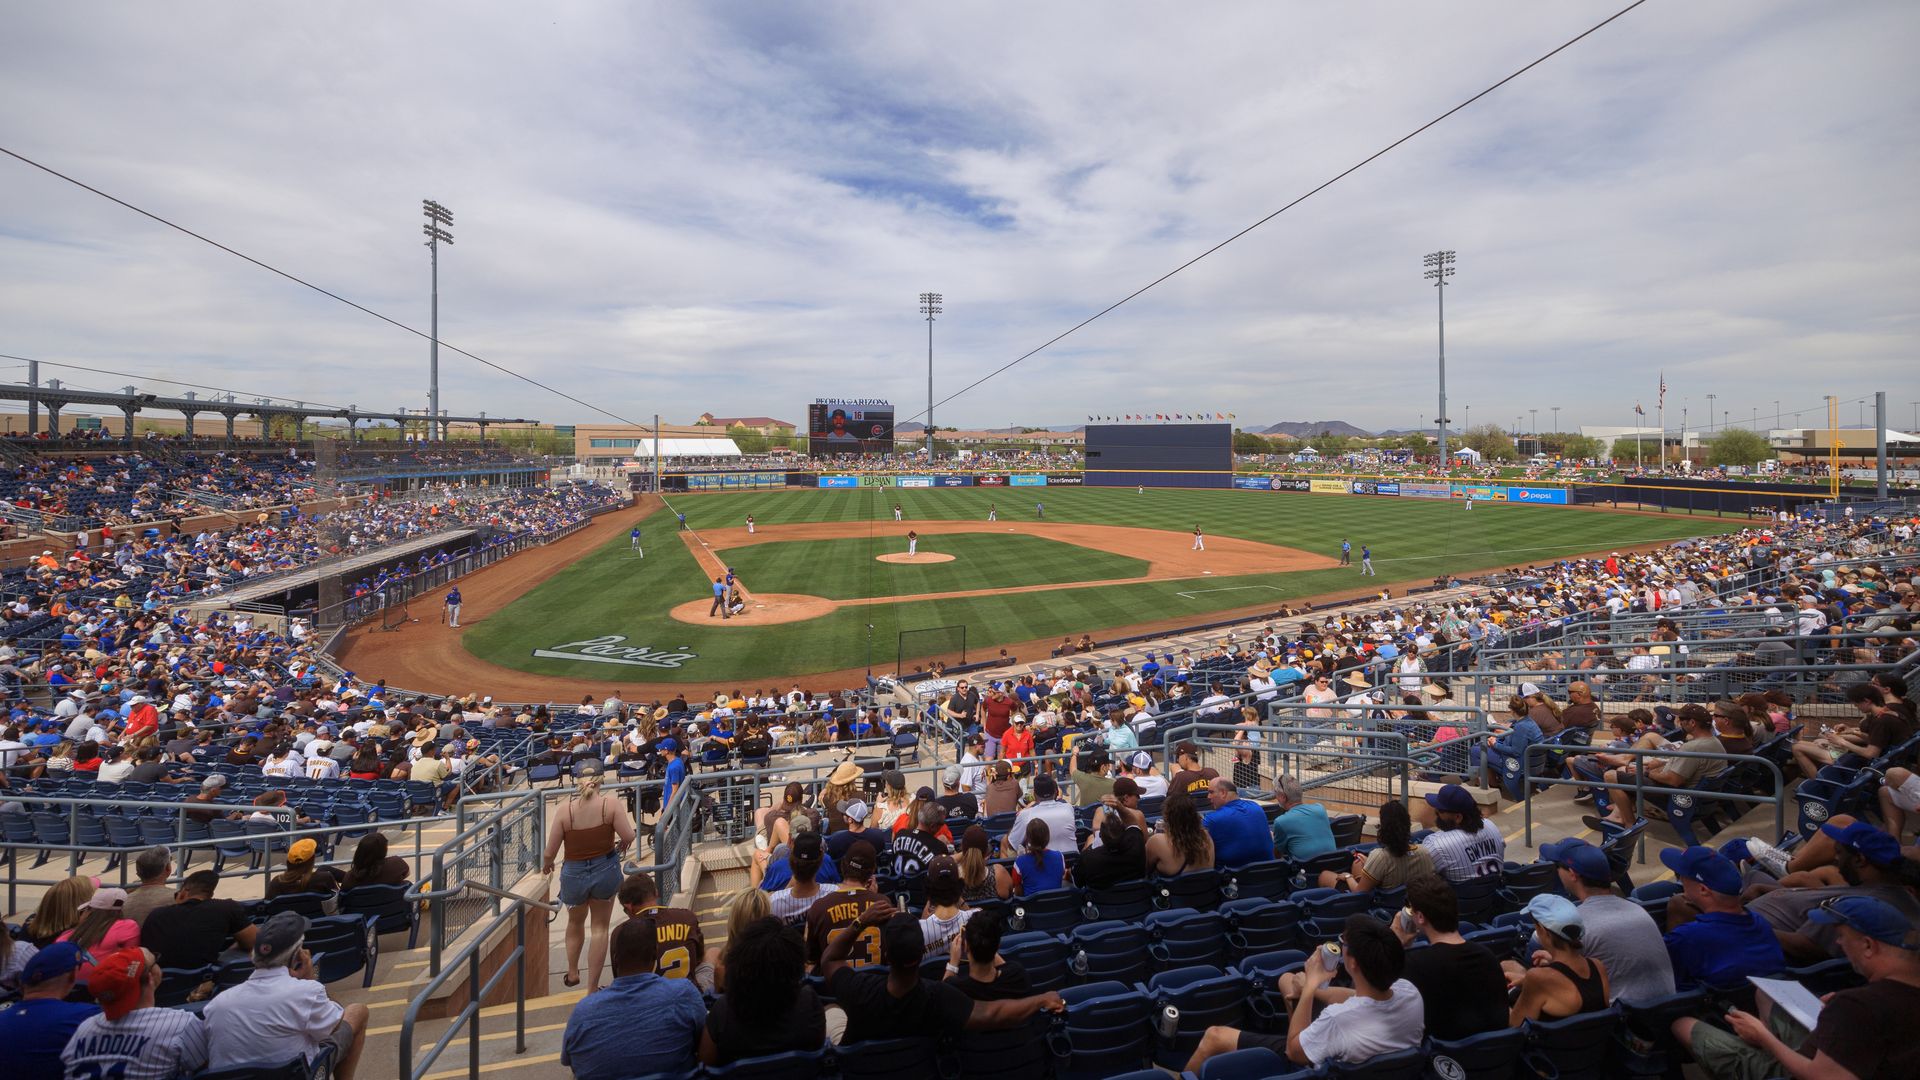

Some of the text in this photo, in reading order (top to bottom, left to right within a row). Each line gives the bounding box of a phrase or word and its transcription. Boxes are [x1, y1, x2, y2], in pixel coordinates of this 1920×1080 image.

[852, 398, 889, 406] ARIZONA
[854, 411, 862, 420] 16
[864, 476, 891, 485] ELYSIAN
[1530, 492, 1552, 500] pepsi
[545, 635, 698, 667] Peoria
[311, 768, 322, 779] 11
[276, 814, 290, 823] 102
[1465, 838, 1497, 862] GWYNN
[827, 902, 859, 923] TATIS
[75, 1034, 151, 1059] MADDUX
